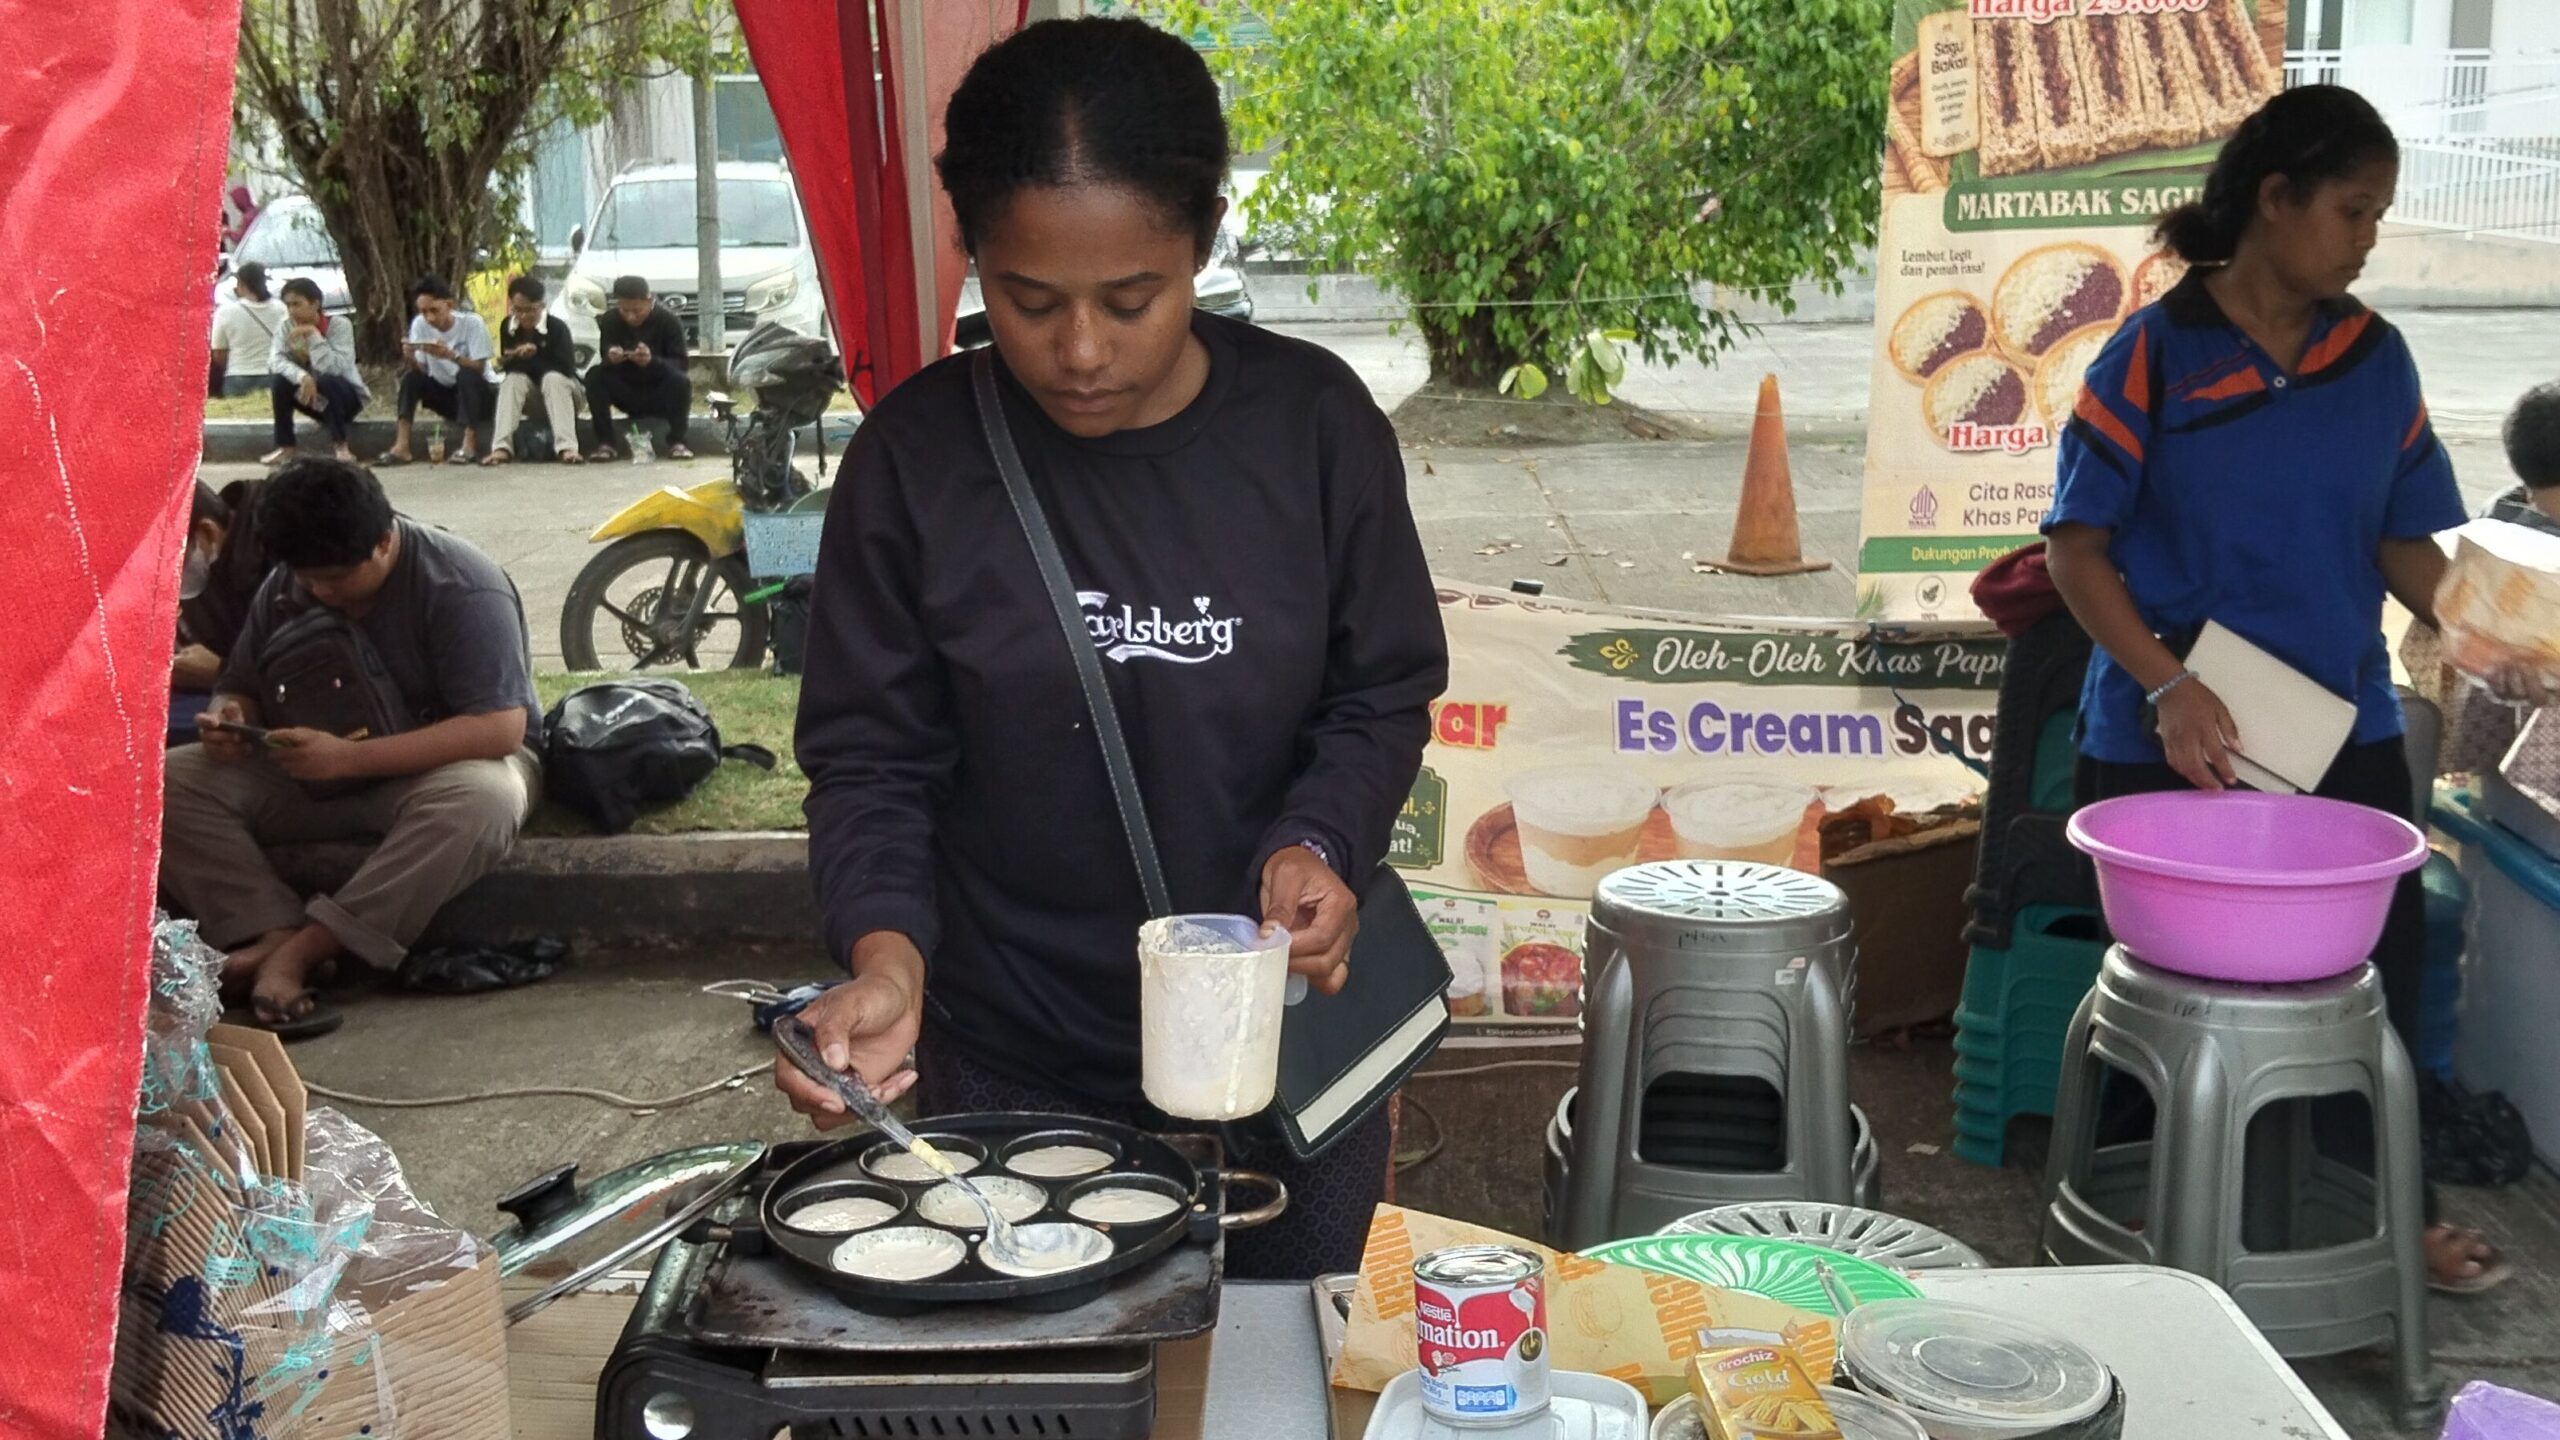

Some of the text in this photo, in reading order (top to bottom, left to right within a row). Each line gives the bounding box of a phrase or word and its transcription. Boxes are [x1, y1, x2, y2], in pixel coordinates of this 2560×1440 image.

[1934, 42, 1964, 57] Sagu
[1931, 57, 1968, 74] Bakar
[1957, 188, 2112, 221] MARTABAK
[1951, 425, 2044, 451] Harga
[1969, 482, 2008, 501] Cita
[1963, 508, 2011, 526] Khas
[1911, 546, 1976, 565] Dukungan
[1652, 637, 1827, 678] Oleh-Oleh
[1836, 642, 1923, 678] Khas
[1429, 700, 1508, 749] ar
[1618, 700, 1996, 761] Es Cream Sag
[1727, 1369, 1791, 1387] Gold
